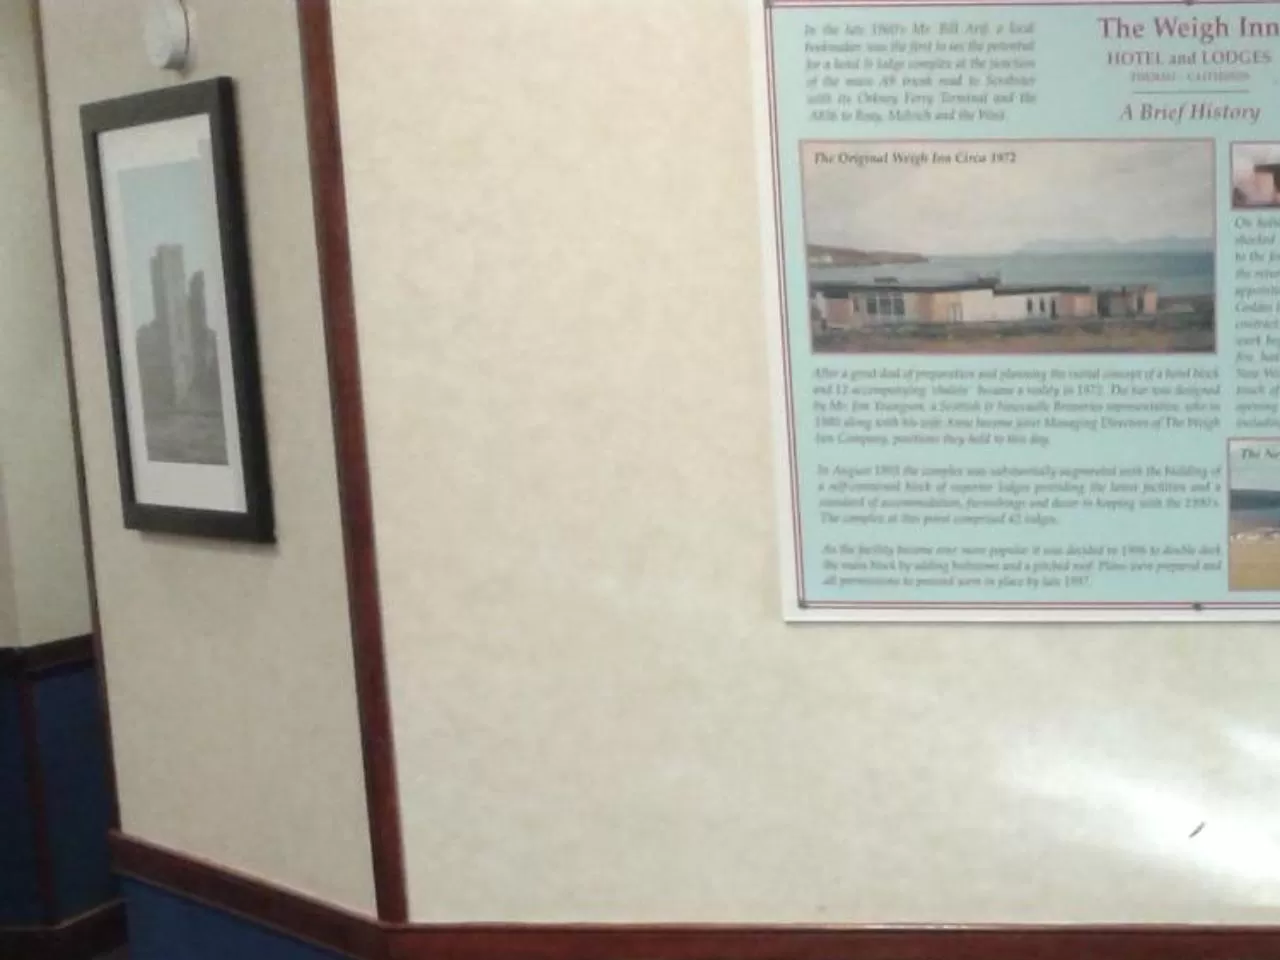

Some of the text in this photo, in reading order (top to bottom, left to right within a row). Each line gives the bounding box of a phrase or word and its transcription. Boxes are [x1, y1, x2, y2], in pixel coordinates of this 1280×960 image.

[1097, 15, 1280, 44] The Weigh Inn
[1107, 50, 1272, 65] HOTEL and LODGES
[1120, 101, 1260, 125] A Brief History
[815, 152, 1016, 167] The Original Weigh Inn Circa 1972
[1242, 447, 1260, 459] The
